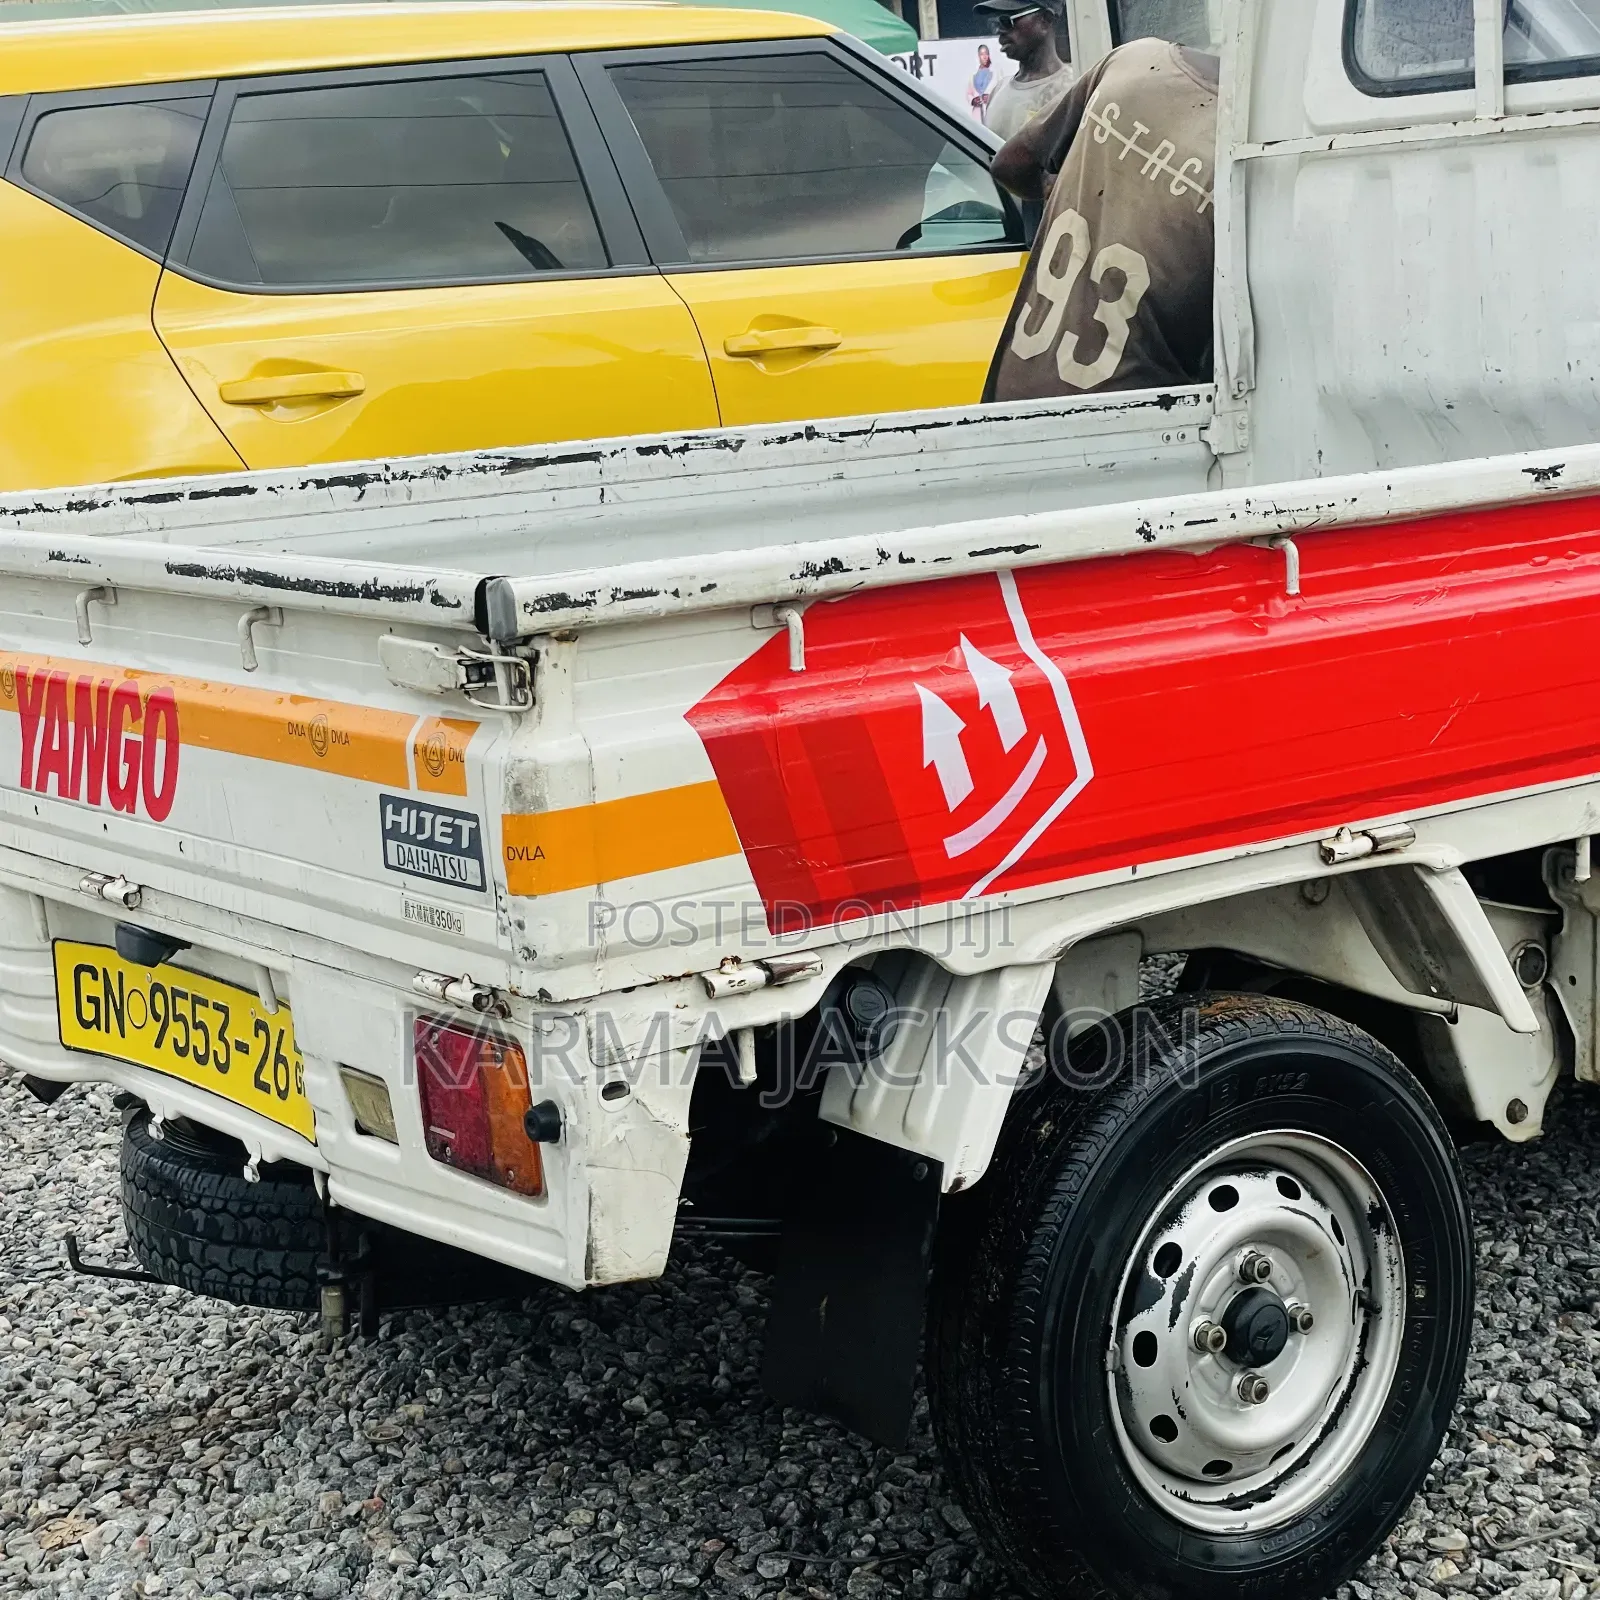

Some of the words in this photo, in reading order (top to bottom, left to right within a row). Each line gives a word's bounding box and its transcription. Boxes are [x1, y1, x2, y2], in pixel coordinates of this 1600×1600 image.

[1011, 208, 1150, 390] 93
[15, 665, 180, 822] YANGO
[288, 721, 306, 737] DVLA
[331, 729, 350, 746] DVLA
[448, 747, 465, 763] DVL
[385, 803, 478, 849] HIJET
[396, 844, 469, 882] DAIHATSU
[506, 845, 546, 861] DVLA
[73, 963, 126, 1039] GN
[149, 981, 290, 1101] 9553-26
